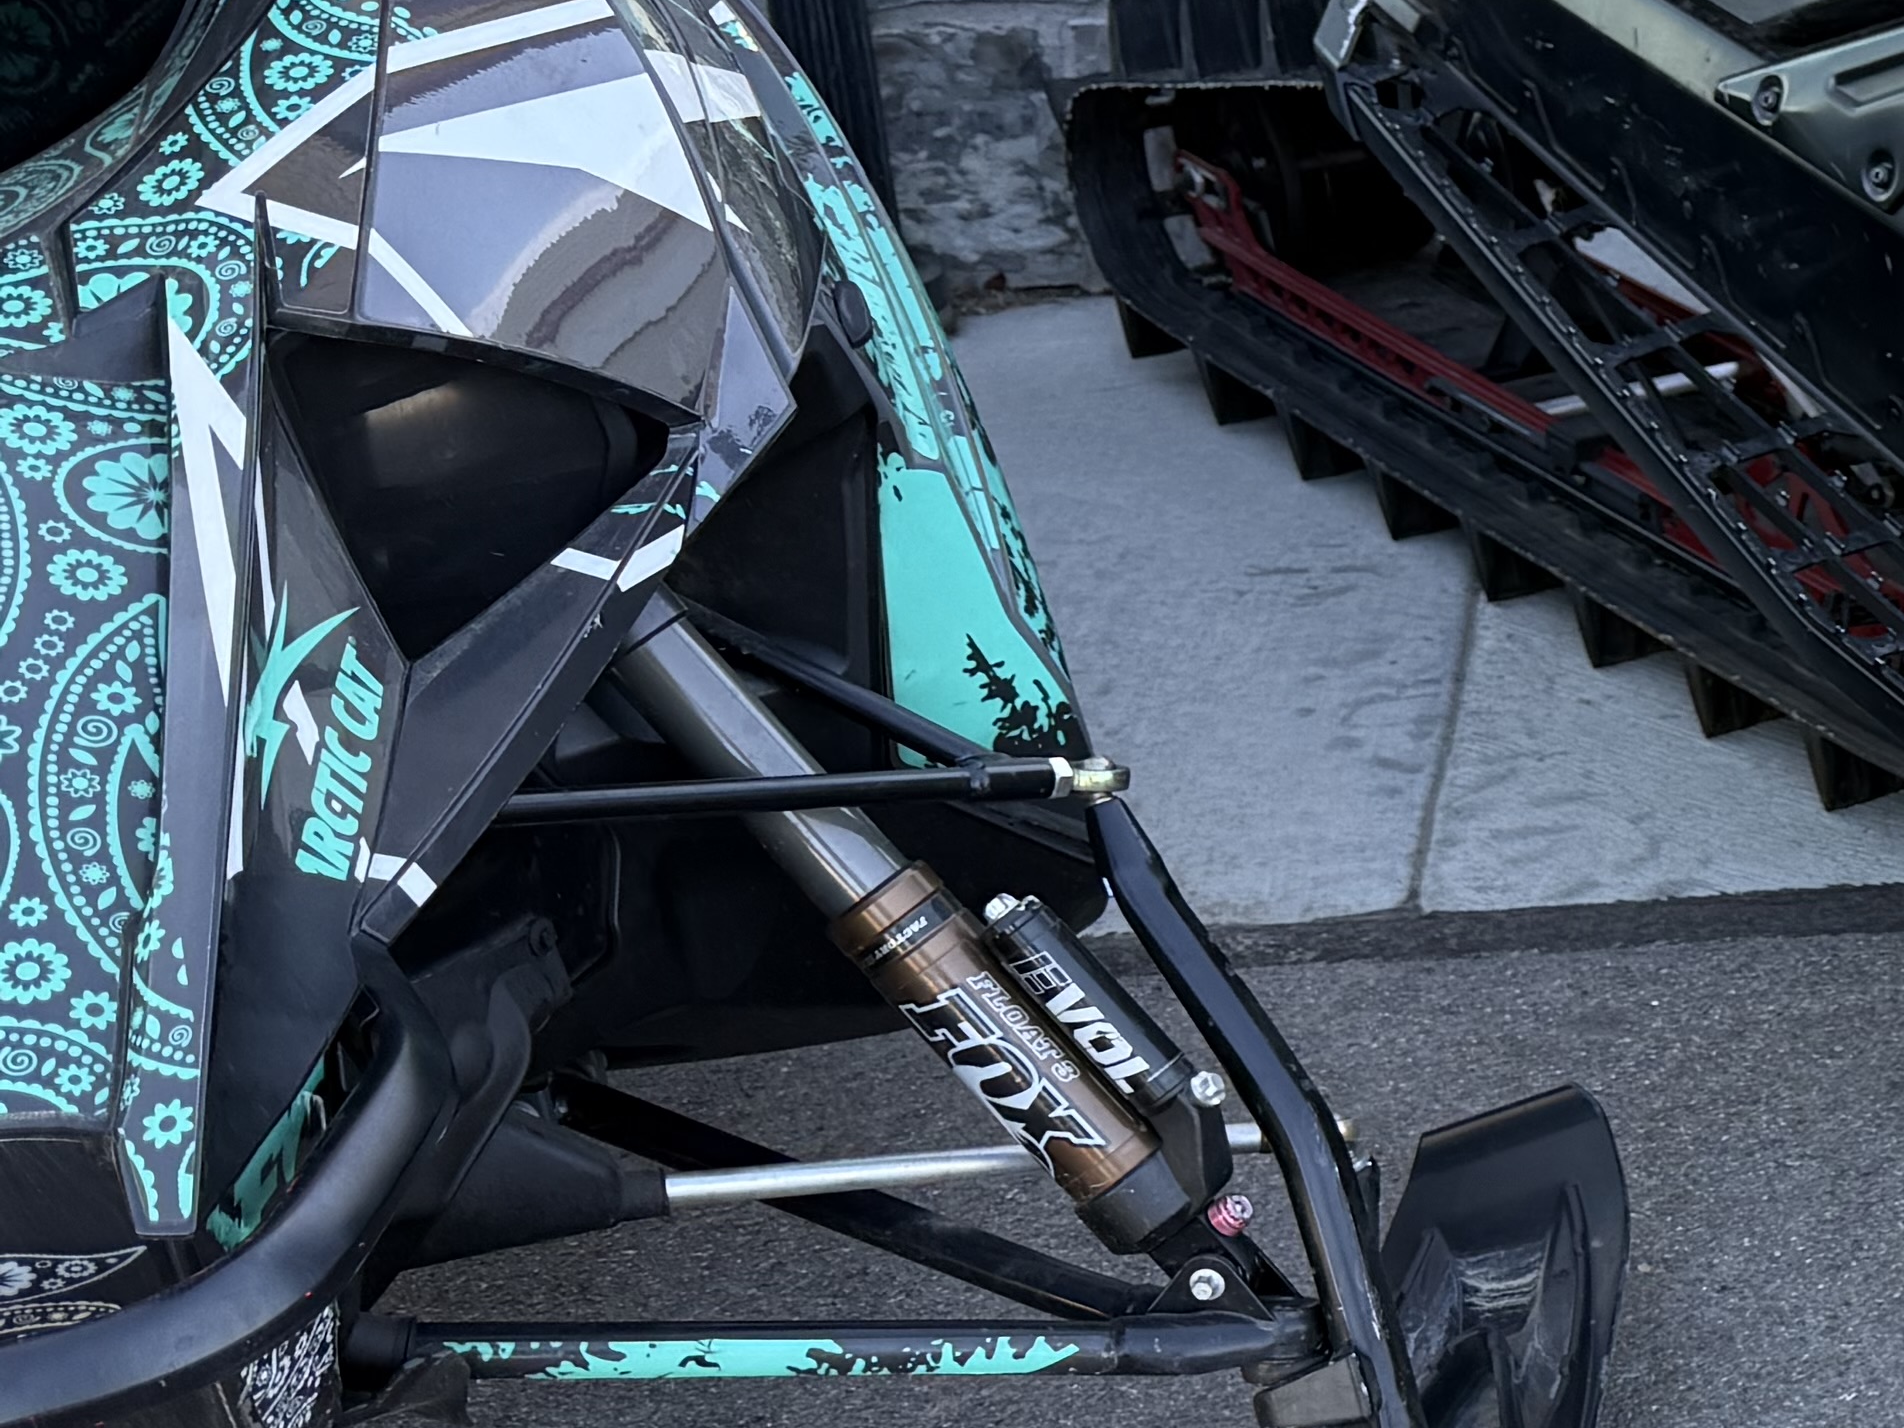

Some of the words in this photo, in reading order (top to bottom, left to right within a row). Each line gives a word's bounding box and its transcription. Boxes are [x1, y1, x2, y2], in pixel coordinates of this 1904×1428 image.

[330, 643, 385, 741] CAT
[295, 726, 372, 881] ARCTIC
[873, 915, 928, 960] FACTORY
[899, 986, 1107, 1178] FOX
[967, 970, 1064, 1061] FLOAT
[1051, 1060, 1081, 1083] 3
